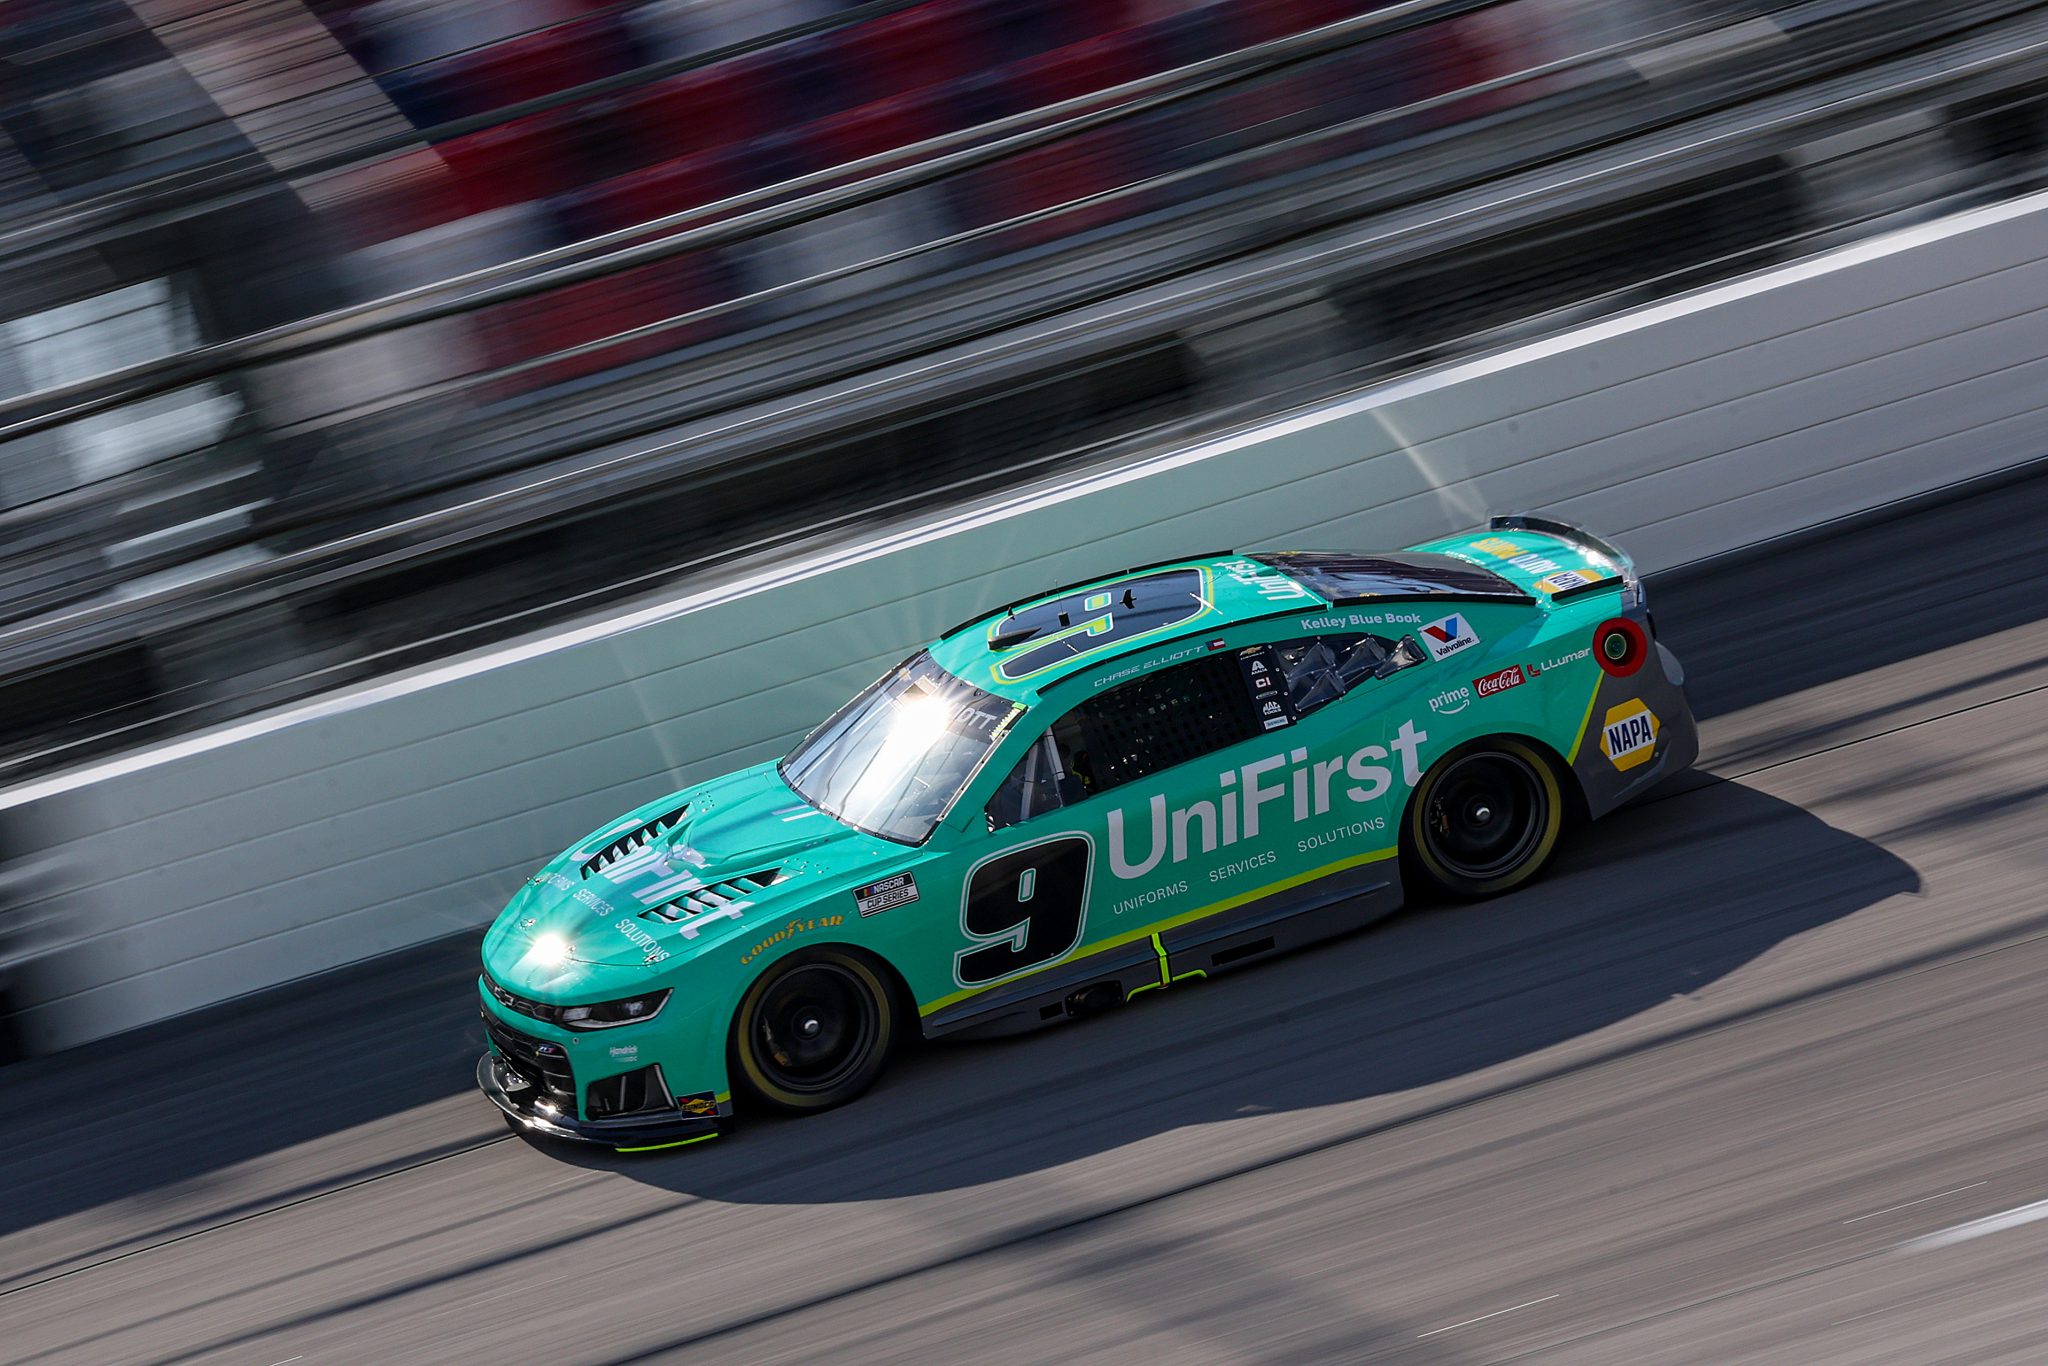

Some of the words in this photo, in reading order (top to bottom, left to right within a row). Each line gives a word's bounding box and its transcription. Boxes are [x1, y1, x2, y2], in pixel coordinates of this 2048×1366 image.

[1301, 618, 1346, 630] Kelley
[1350, 614, 1382, 625] Blue
[1386, 613, 1421, 624] Book
[1094, 663, 1140, 688] CHASE
[1143, 645, 1204, 669] ELLIOTT
[1435, 637, 1472, 656] Valvoline
[1428, 686, 1470, 712] prime
[1608, 715, 1653, 756] NAPA
[1107, 719, 1427, 880] UniFirst
[873, 877, 905, 894] NASCAR
[1113, 880, 1188, 915] UNIFORMS
[1209, 851, 1277, 883] SERVICES
[1298, 817, 1386, 853] SOLUTIONS
[867, 897, 882, 909] CUP
[882, 889, 909, 903] SERIES
[952, 830, 1096, 989] 9
[573, 888, 615, 917] SERVICES
[615, 918, 670, 964] SOLUTIONS
[740, 915, 843, 965] GOODYEAR
[681, 1100, 717, 1113] SUNOCO
